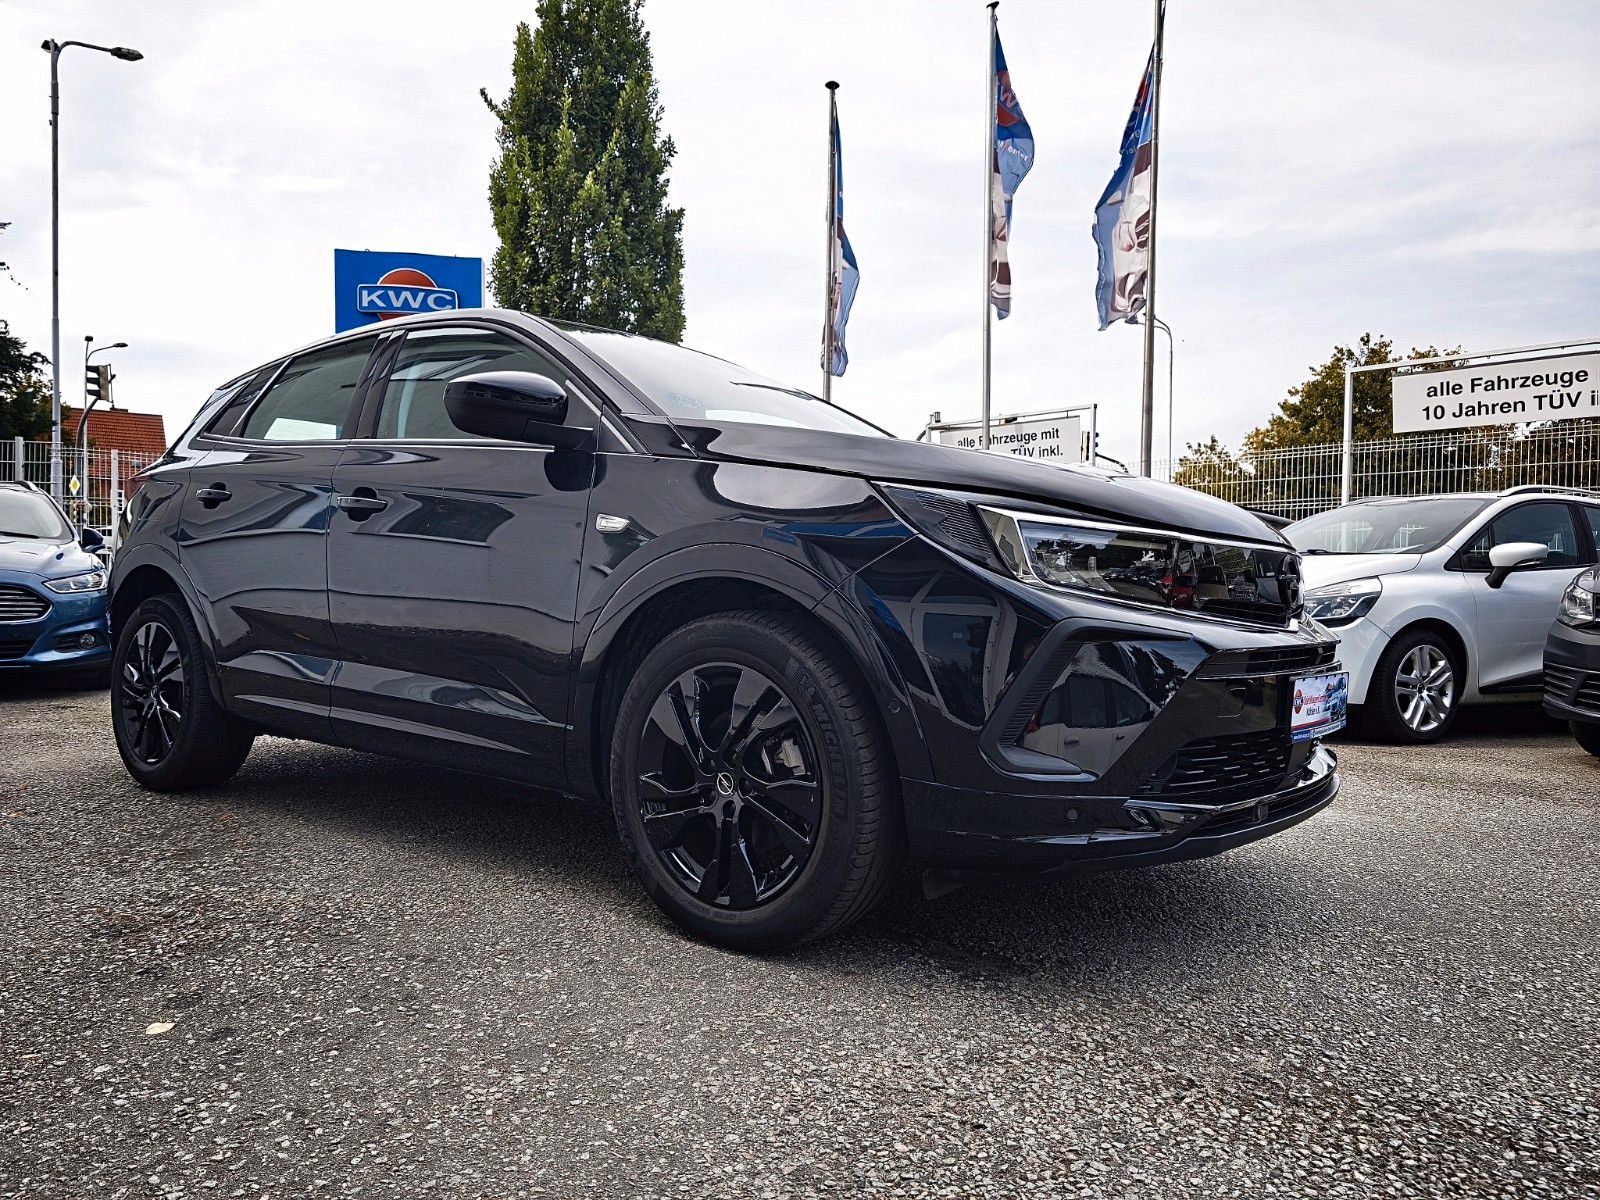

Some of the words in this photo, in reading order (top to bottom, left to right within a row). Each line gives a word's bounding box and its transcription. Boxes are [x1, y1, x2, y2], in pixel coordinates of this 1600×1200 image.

[361, 290, 453, 310] KWC
[1426, 381, 1463, 398] alle
[1470, 369, 1589, 394] Fahrzeuge
[1422, 405, 1445, 421] 10
[1452, 399, 1526, 418] Jahren
[1533, 390, 1583, 411] TÜV
[957, 437, 976, 448] alle
[978, 432, 1038, 447] Fhrzeuge
[1041, 428, 1060, 441] mit
[1038, 444, 1064, 458] inkl.
